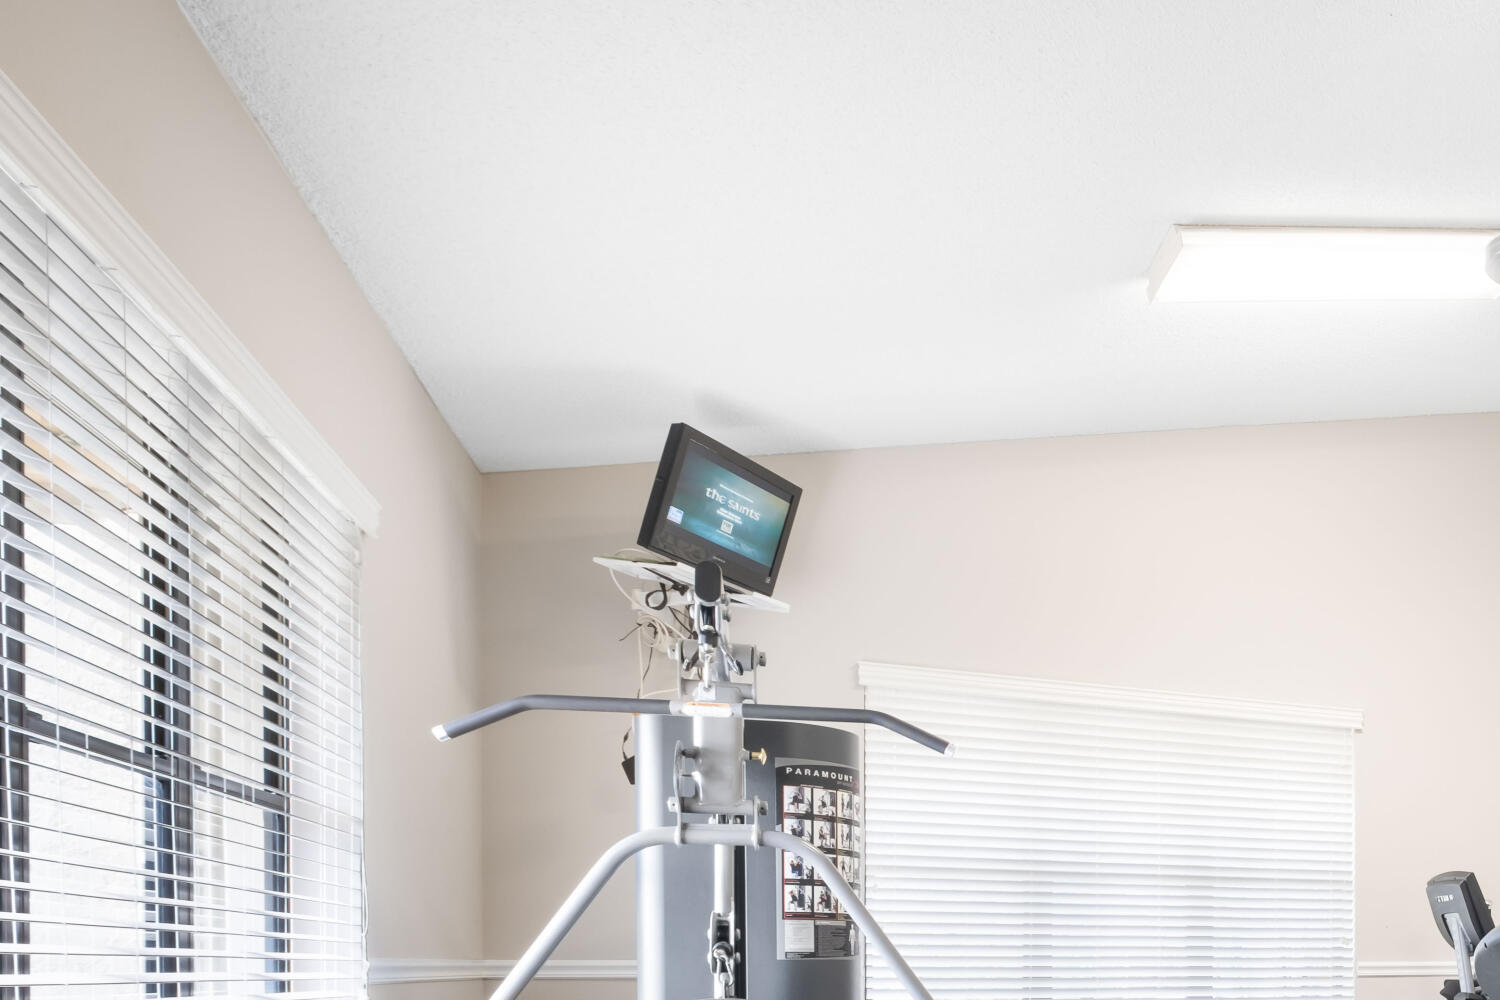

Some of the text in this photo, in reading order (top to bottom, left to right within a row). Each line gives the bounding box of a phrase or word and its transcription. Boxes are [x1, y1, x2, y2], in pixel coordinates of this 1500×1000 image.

[705, 487, 726, 504] the
[728, 499, 761, 521] saints
[785, 767, 853, 782] PARAMOUNT
